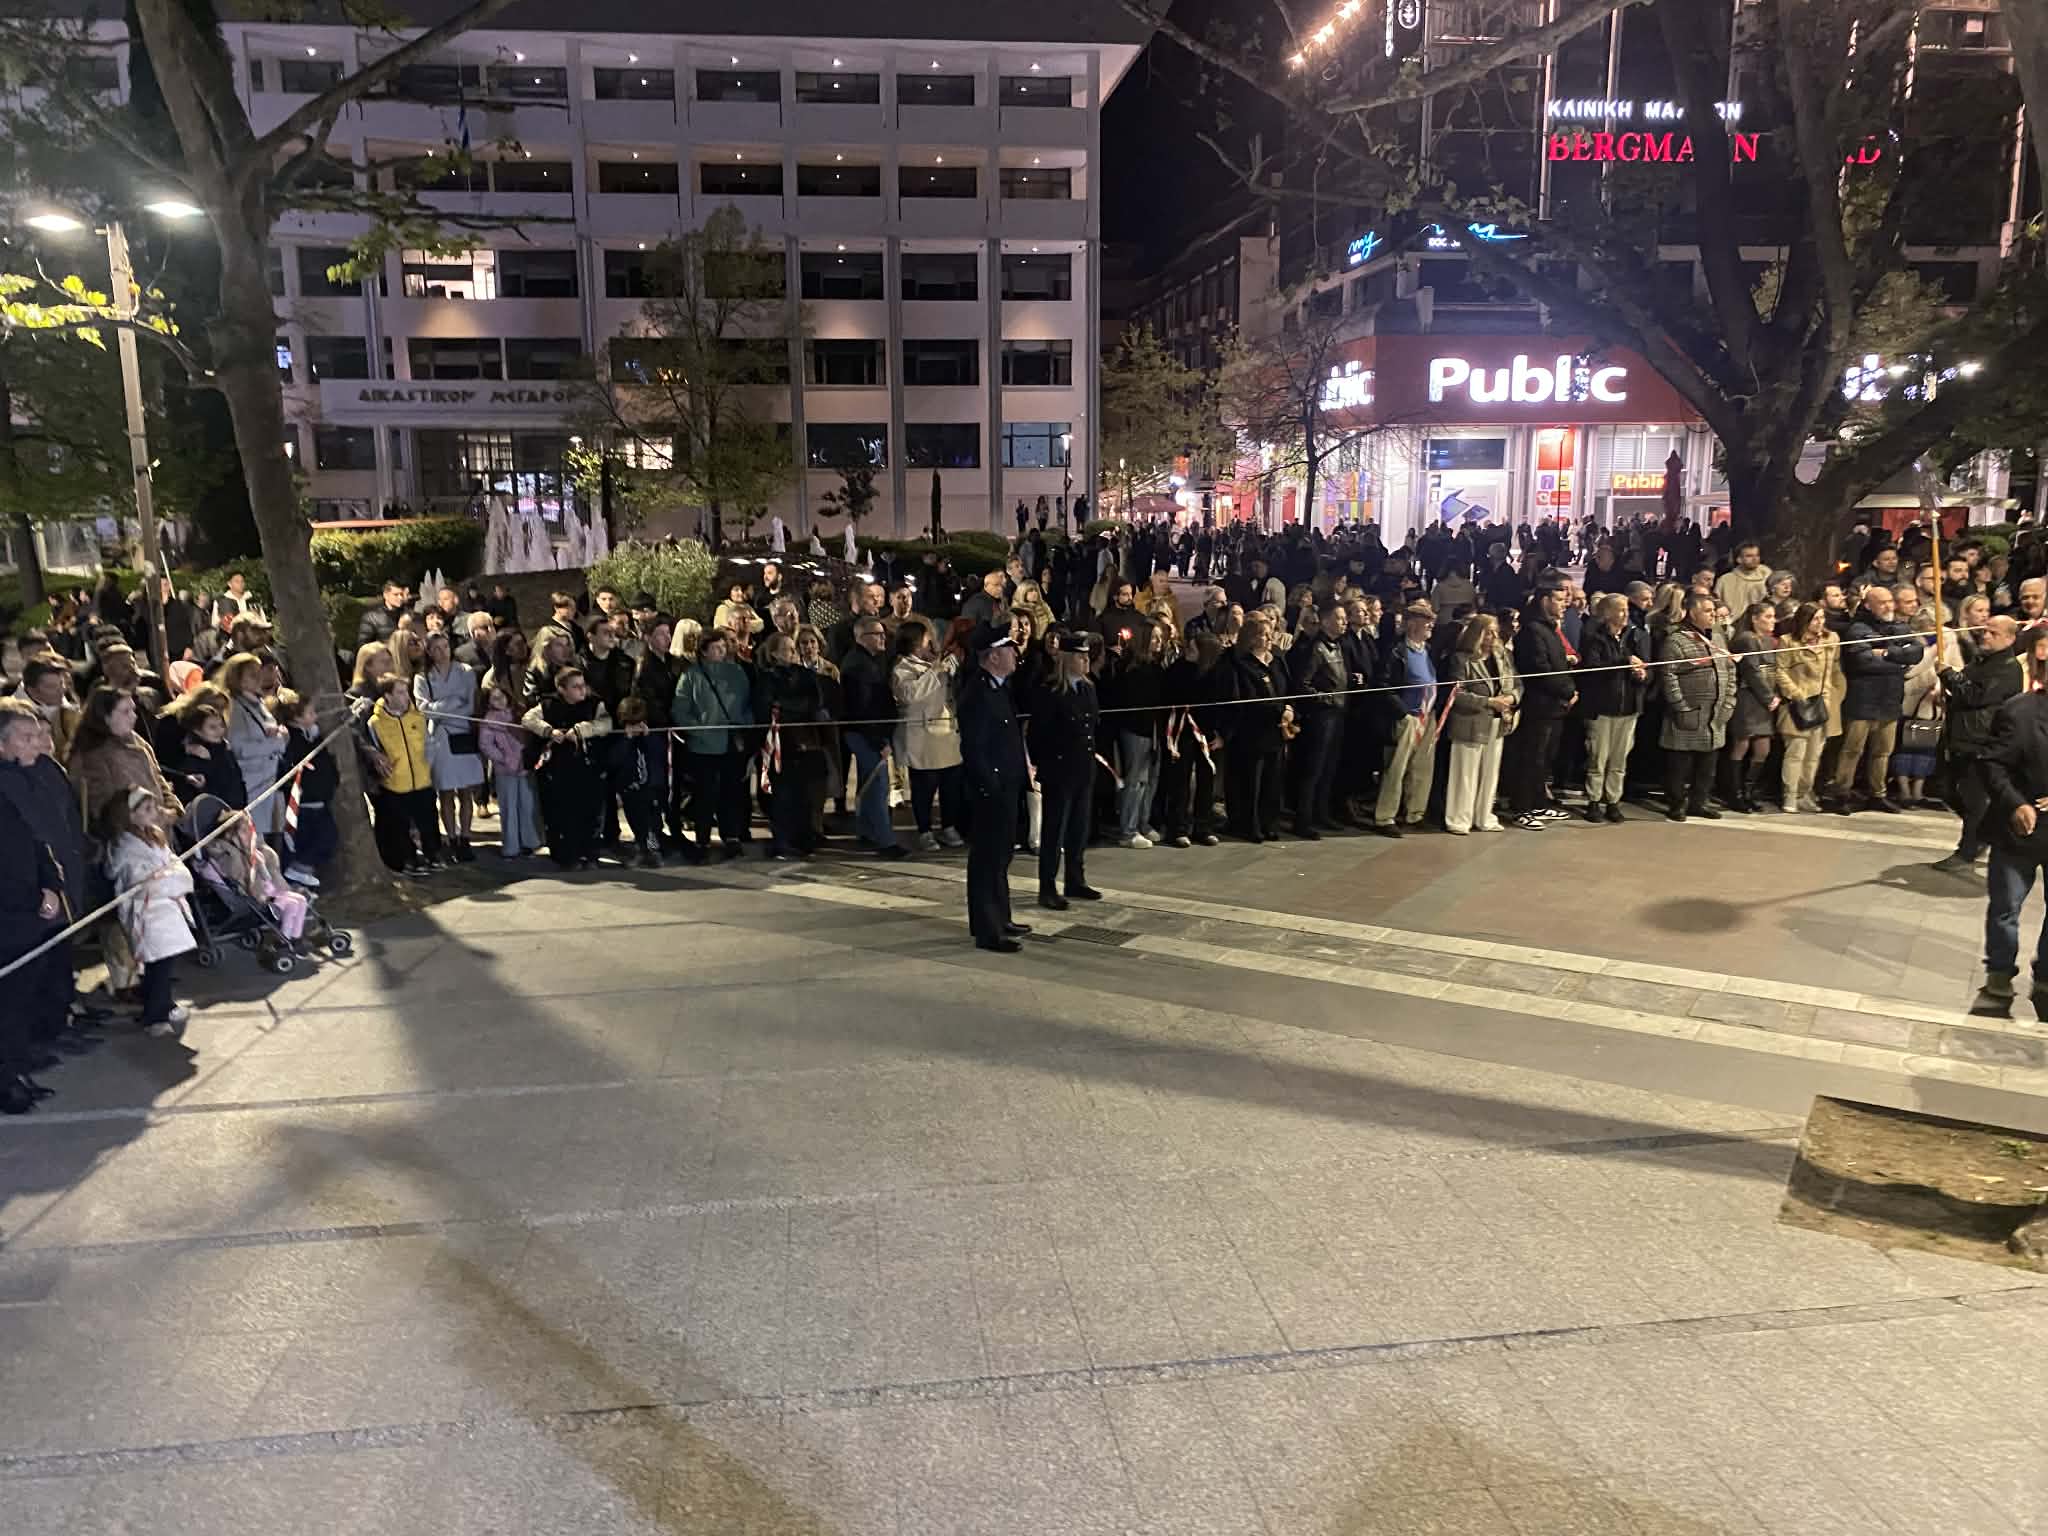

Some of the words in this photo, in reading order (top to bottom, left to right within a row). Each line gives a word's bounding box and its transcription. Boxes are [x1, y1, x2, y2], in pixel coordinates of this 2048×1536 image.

[1548, 132, 1760, 162] BERGMAN
[1428, 353, 1626, 402] Public
[1613, 473, 1664, 489] Publi
